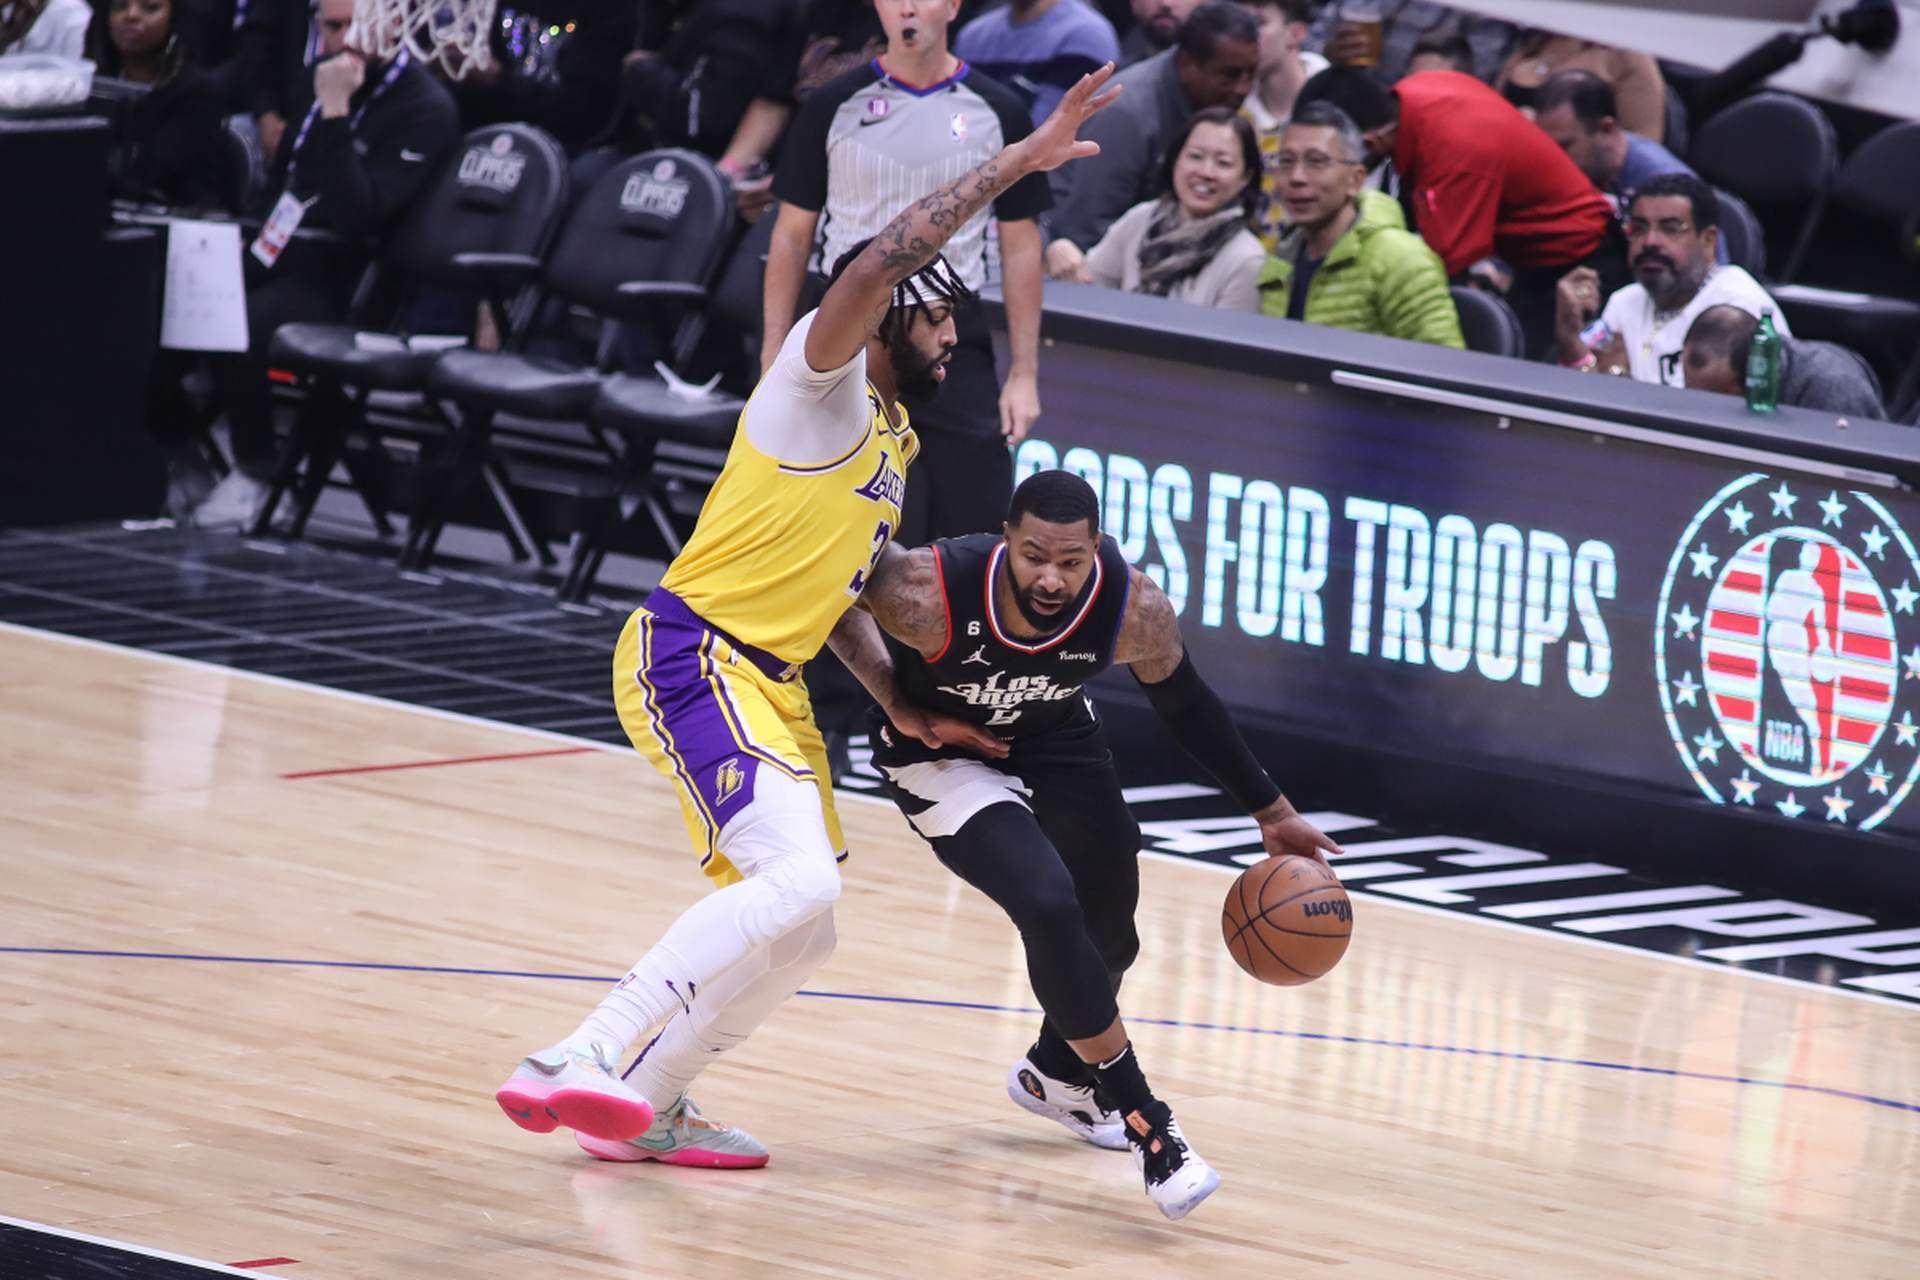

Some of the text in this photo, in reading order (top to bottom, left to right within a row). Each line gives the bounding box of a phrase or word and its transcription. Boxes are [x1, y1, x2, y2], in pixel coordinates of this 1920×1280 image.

[1201, 471, 1331, 647] FOR
[1344, 495, 1618, 699] TROOPS
[967, 620, 981, 636] 6
[1764, 719, 1805, 762] NBA
